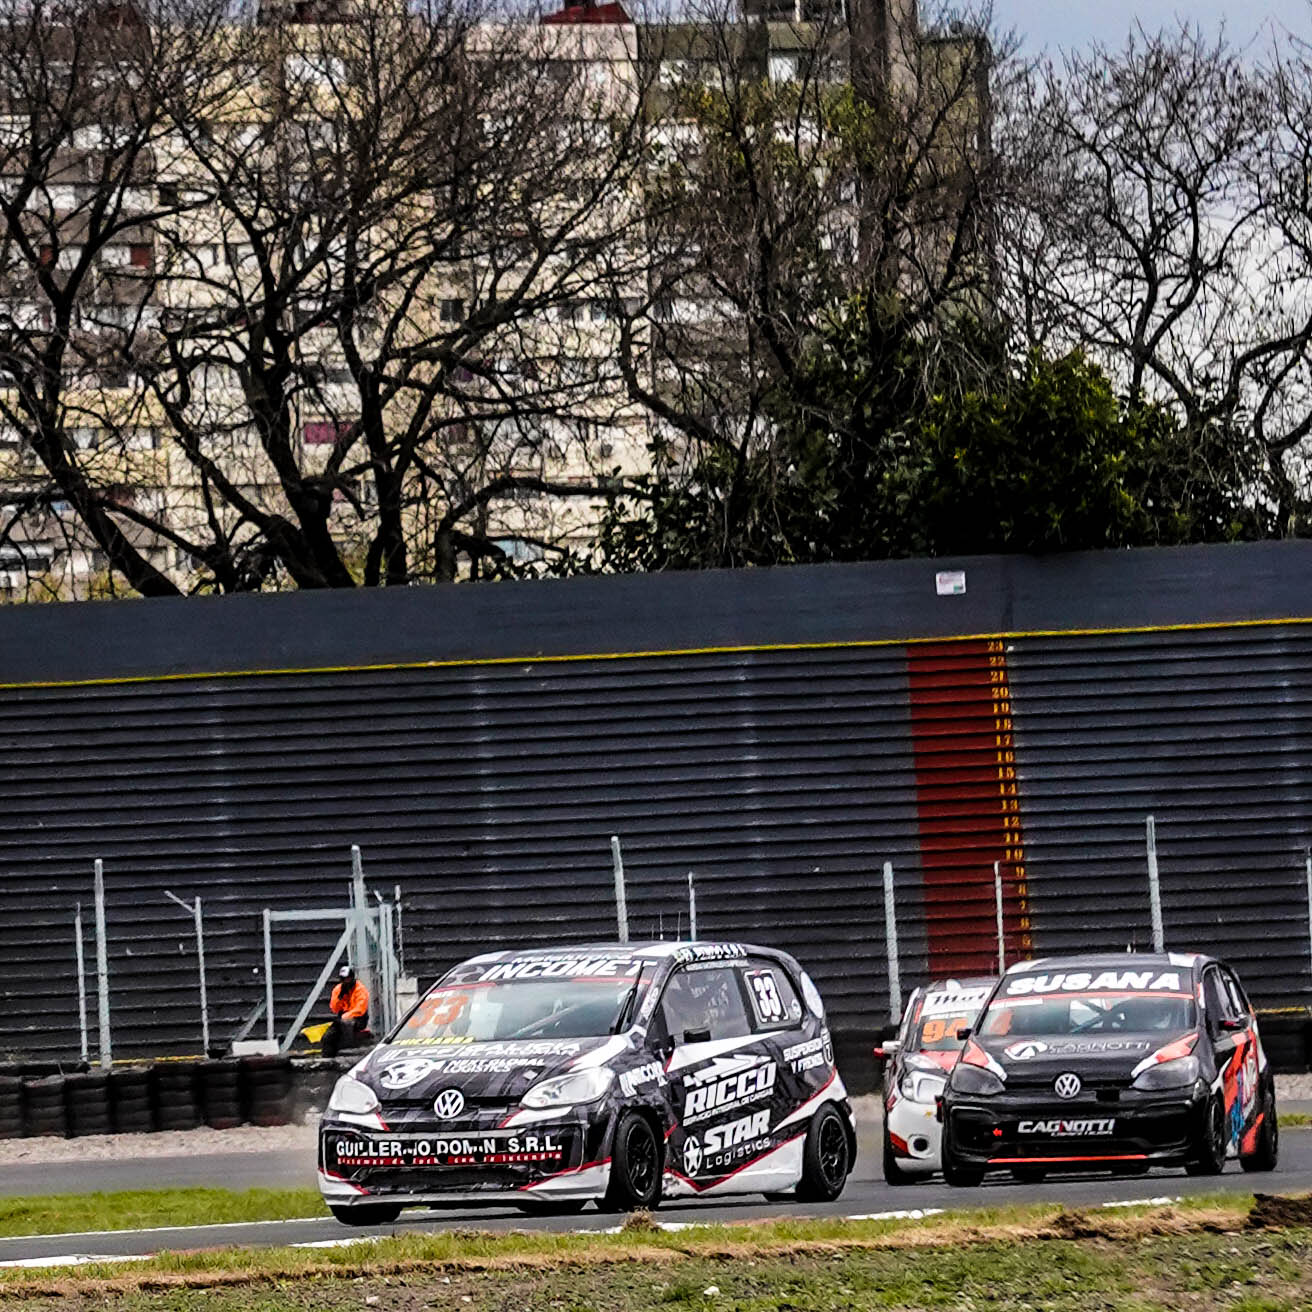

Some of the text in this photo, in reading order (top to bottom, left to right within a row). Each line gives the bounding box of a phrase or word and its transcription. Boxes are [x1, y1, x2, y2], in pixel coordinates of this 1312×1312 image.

[992, 687, 1009, 698] 20
[996, 735, 1011, 746] 17
[999, 767, 1015, 778] 15
[1000, 783, 1016, 794] 14
[1004, 816, 1020, 827] 12
[1005, 832, 1019, 843] 11
[1006, 849, 1024, 860] 10
[478, 959, 657, 982] INCOMET
[1006, 971, 1180, 995] SUSANA
[753, 976, 782, 1016] 33
[488, 1058, 546, 1067] GLOBAL
[443, 1065, 512, 1074] LOGISTICS
[683, 1061, 777, 1118] RICCO
[1017, 1118, 1116, 1134] CAGNOTTI
[703, 1108, 771, 1156] STAR
[507, 1135, 563, 1153] S.R.L.
[706, 1136, 772, 1169] Logistics
